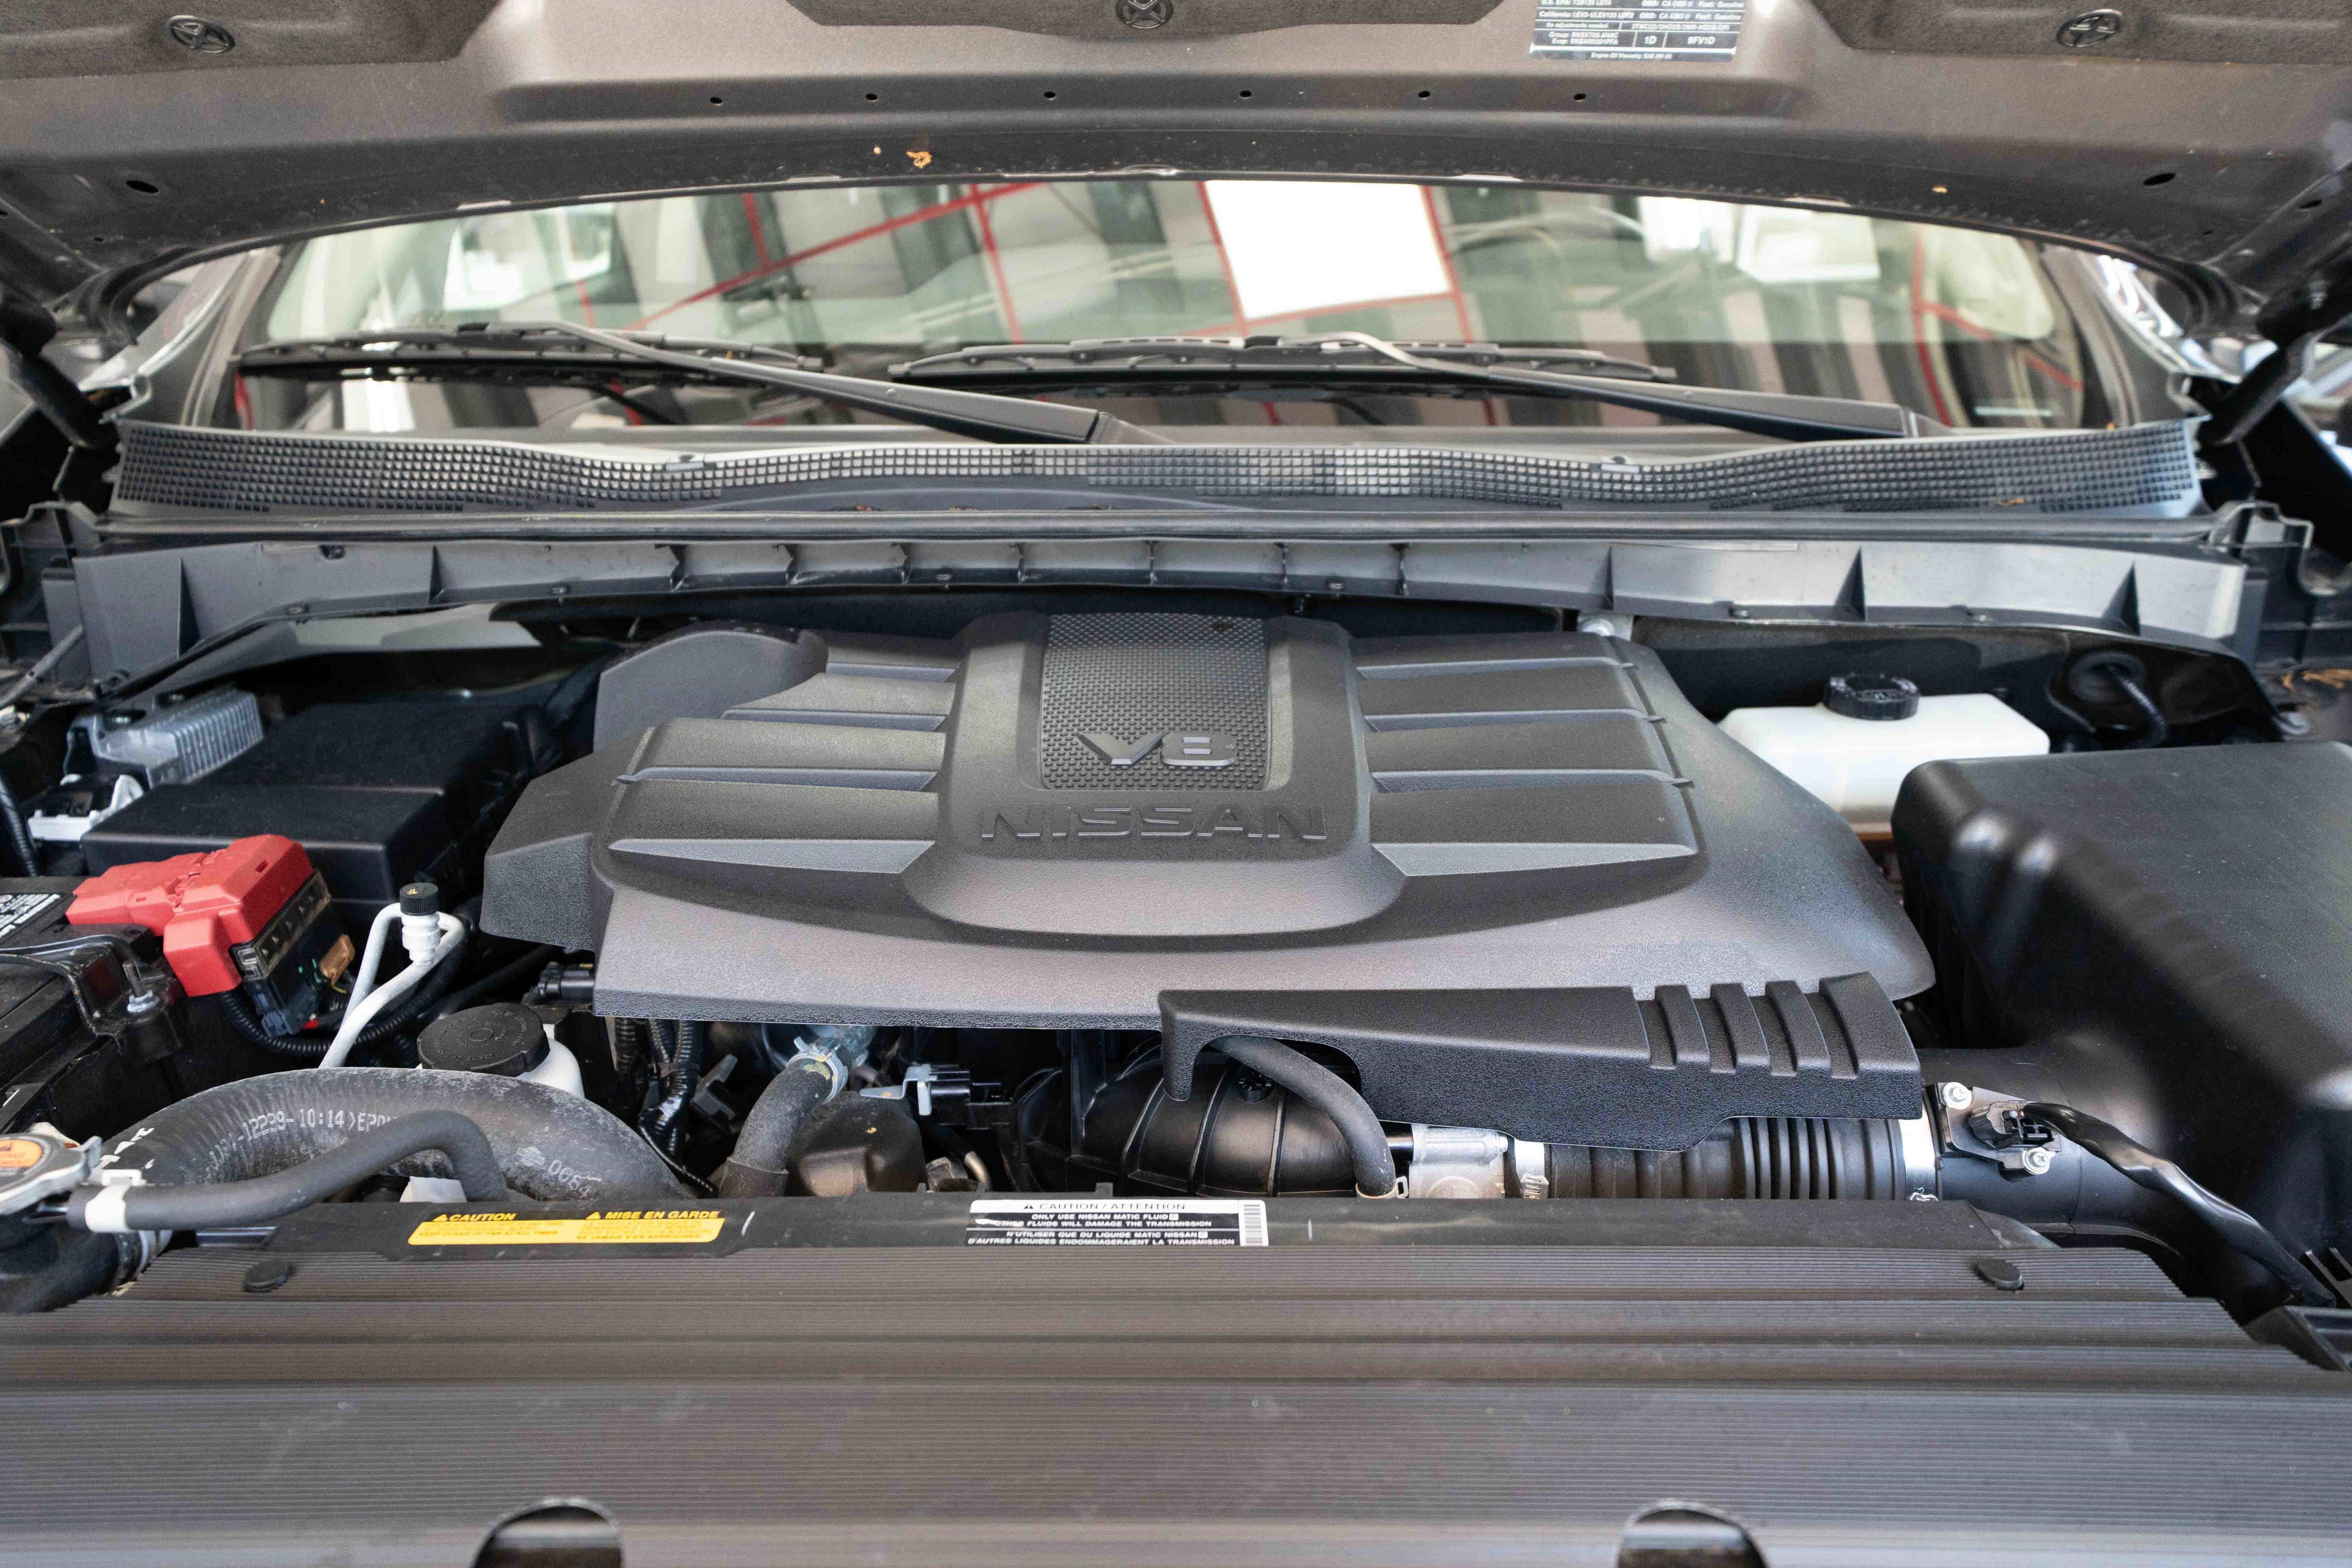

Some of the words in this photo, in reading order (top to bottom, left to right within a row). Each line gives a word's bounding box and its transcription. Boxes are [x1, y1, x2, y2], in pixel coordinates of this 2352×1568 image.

[1644, 36, 1657, 45] 1D
[1076, 731, 1237, 767] V8
[980, 802, 1328, 840] NISSAN
[448, 1213, 517, 1221] CAUTION
[667, 1211, 720, 1219] GARDE
